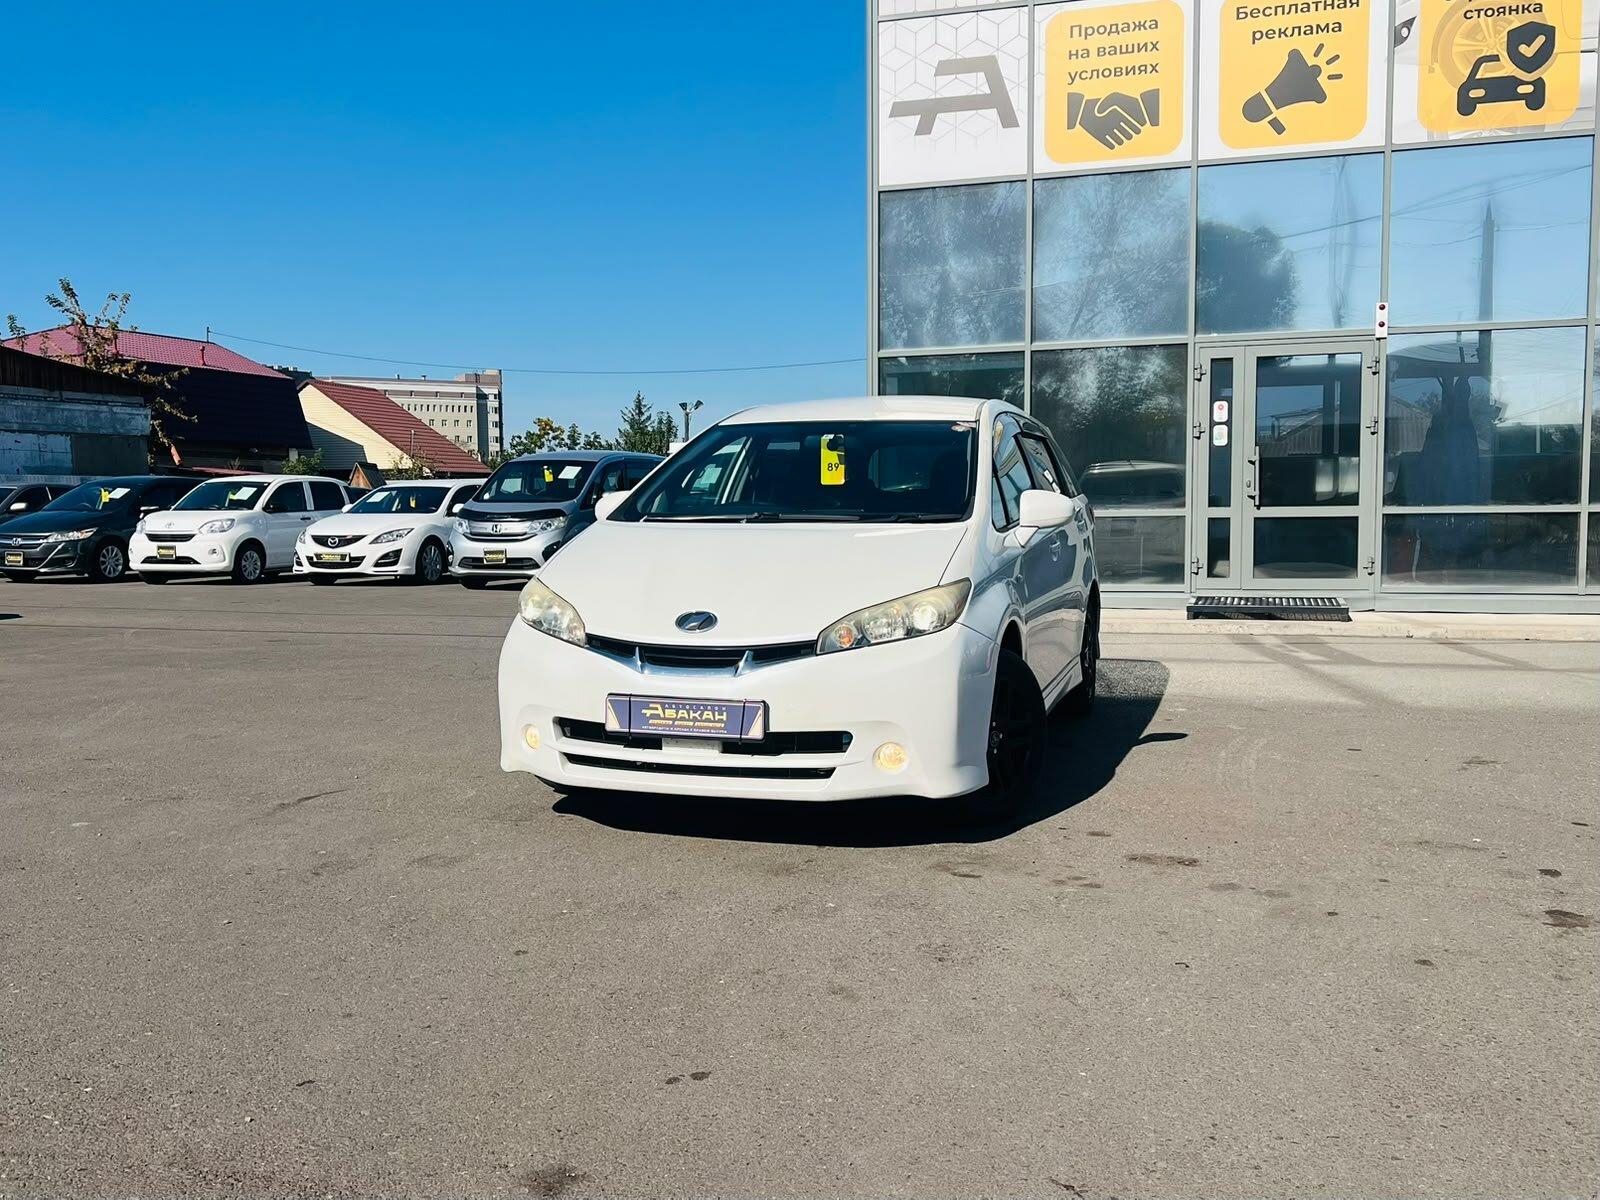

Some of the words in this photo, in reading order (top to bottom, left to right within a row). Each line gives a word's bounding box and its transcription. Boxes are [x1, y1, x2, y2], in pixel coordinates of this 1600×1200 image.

[1236, 0, 1360, 21] Бесплатная
[1463, 2, 1544, 20] стоянка
[1069, 18, 1159, 40] Продажа
[1251, 21, 1342, 45] реклама
[1068, 48, 1090, 60] на
[1096, 40, 1160, 58] ваших
[1067, 62, 1160, 86] условиях
[827, 462, 840, 472] 89
[641, 703, 727, 721] АБАКАН
